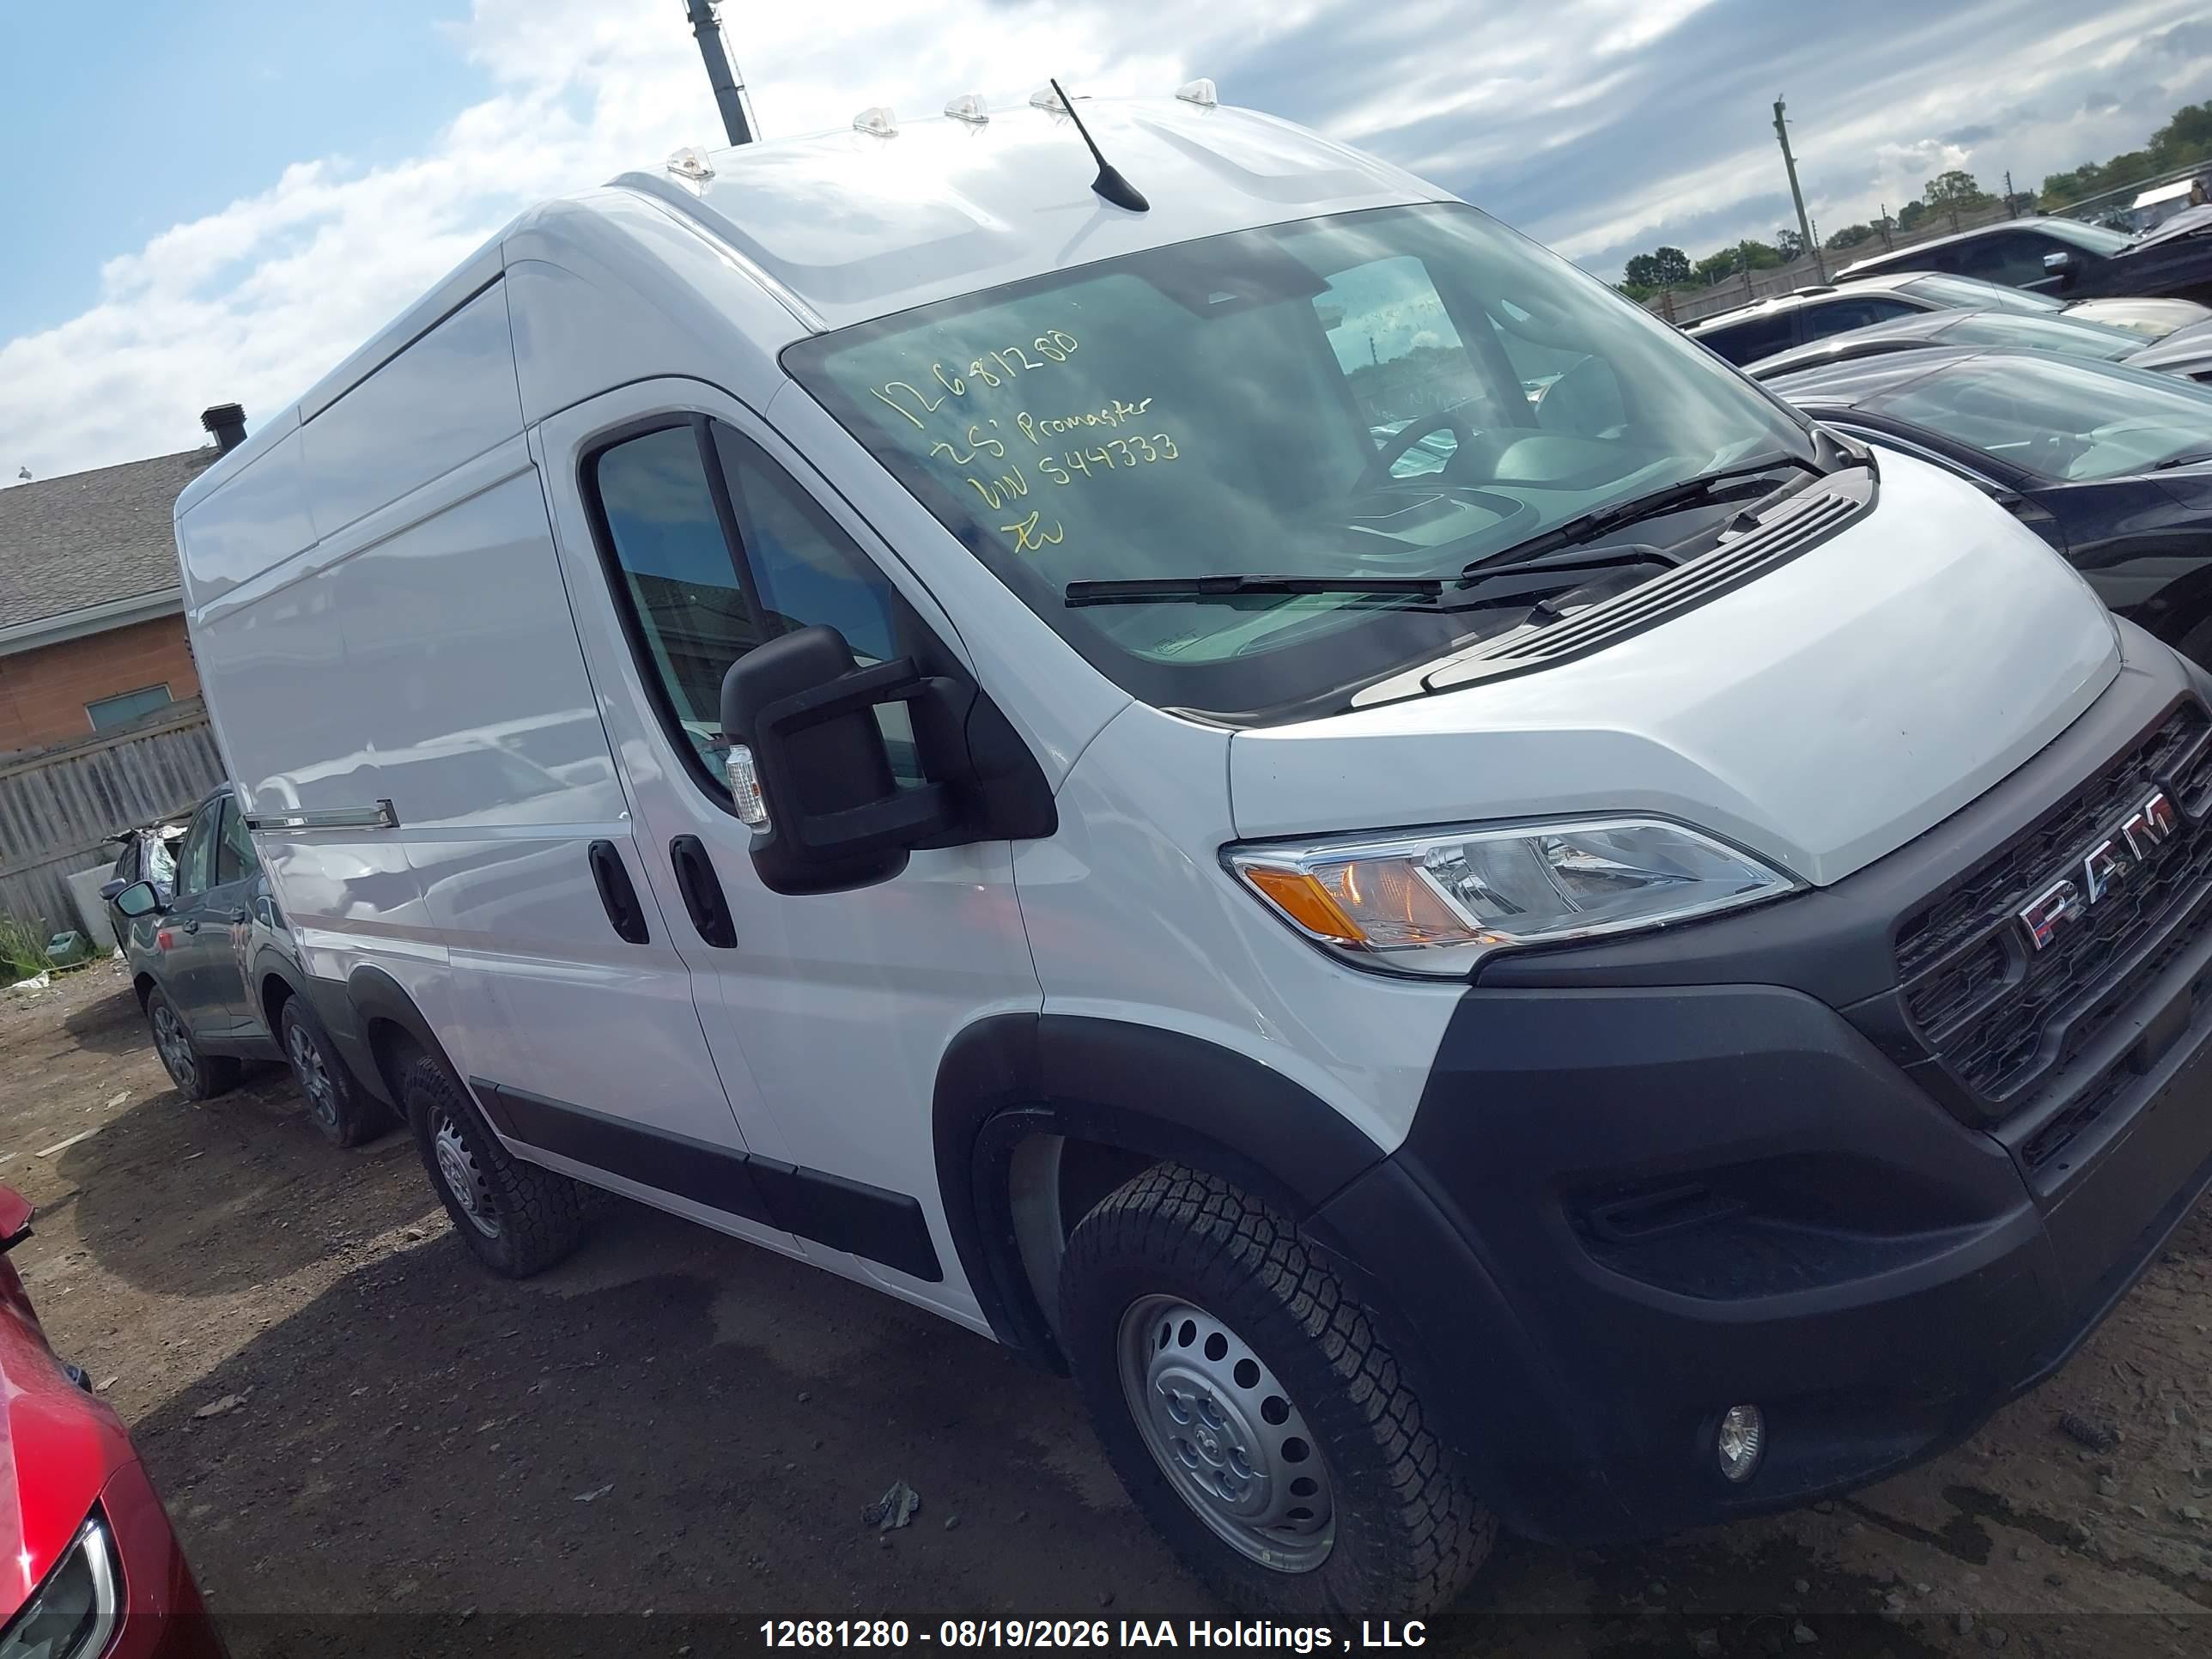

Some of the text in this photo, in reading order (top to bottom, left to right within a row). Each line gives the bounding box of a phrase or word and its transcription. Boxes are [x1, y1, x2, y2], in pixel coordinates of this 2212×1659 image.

[870, 330, 1079, 429] 12681280
[1017, 398, 1154, 446] Promaster
[967, 433, 1180, 509] VIN 544333
[2019, 792, 2179, 951] RAM
